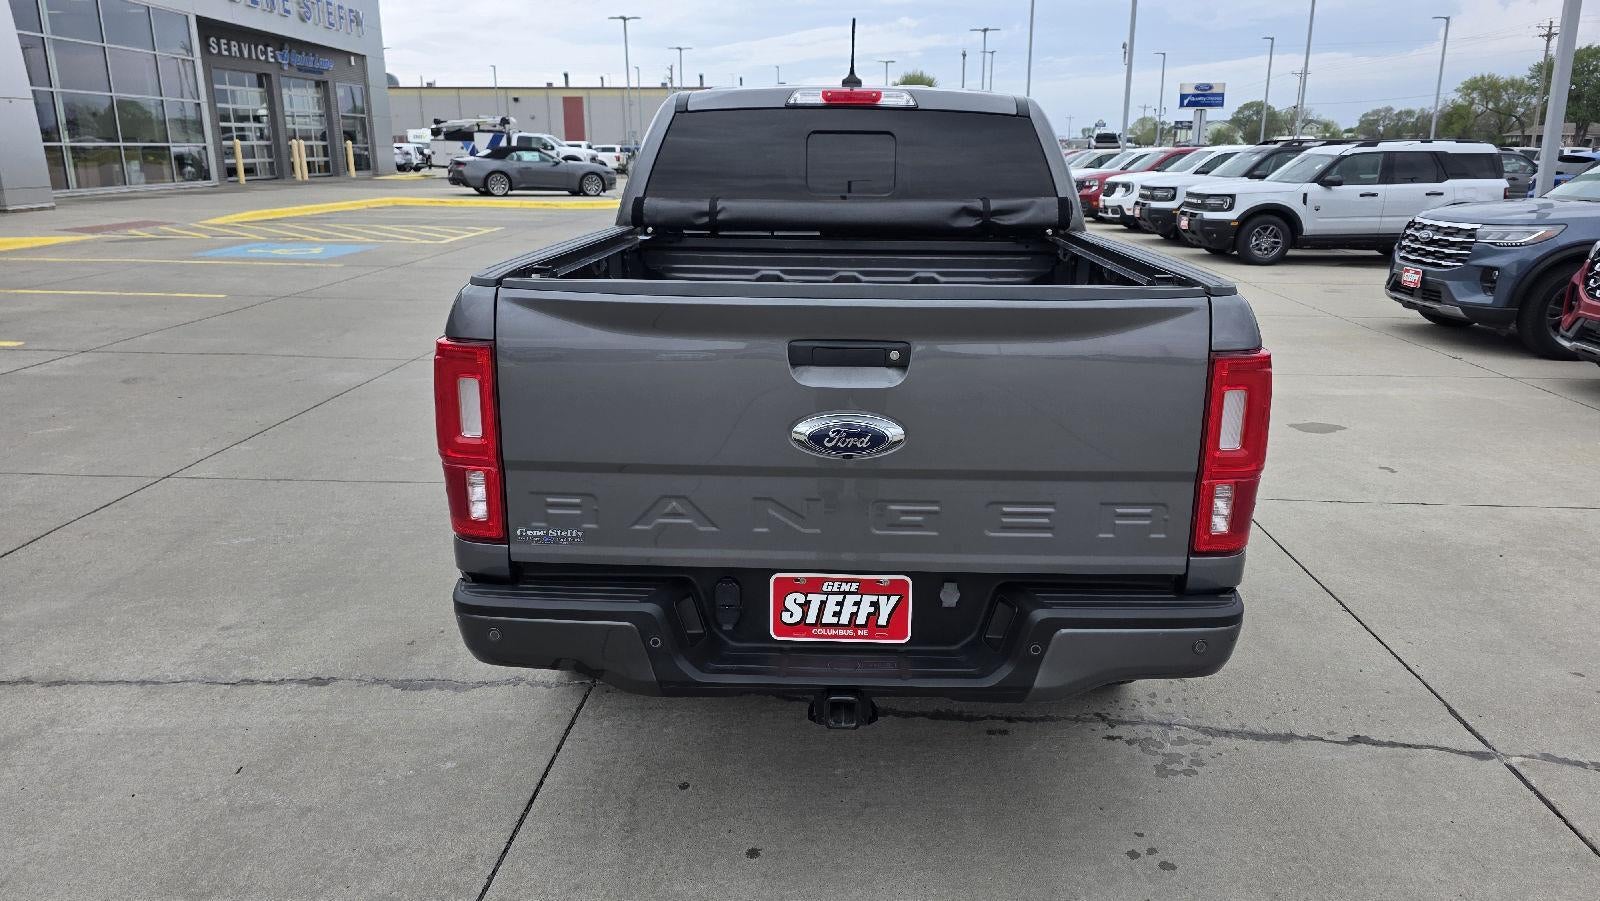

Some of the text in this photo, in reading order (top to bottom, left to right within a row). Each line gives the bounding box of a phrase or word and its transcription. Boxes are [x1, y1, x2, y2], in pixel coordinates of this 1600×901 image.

[299, 0, 365, 37] STEFFY
[208, 36, 276, 63] SERVICE
[823, 427, 872, 448] Ford
[530, 491, 1169, 539] RANGER
[516, 528, 584, 537] Gene Steffy
[821, 581, 861, 592] GENE
[780, 592, 903, 627] STEFFY
[811, 628, 856, 636] COLUMBUS,
